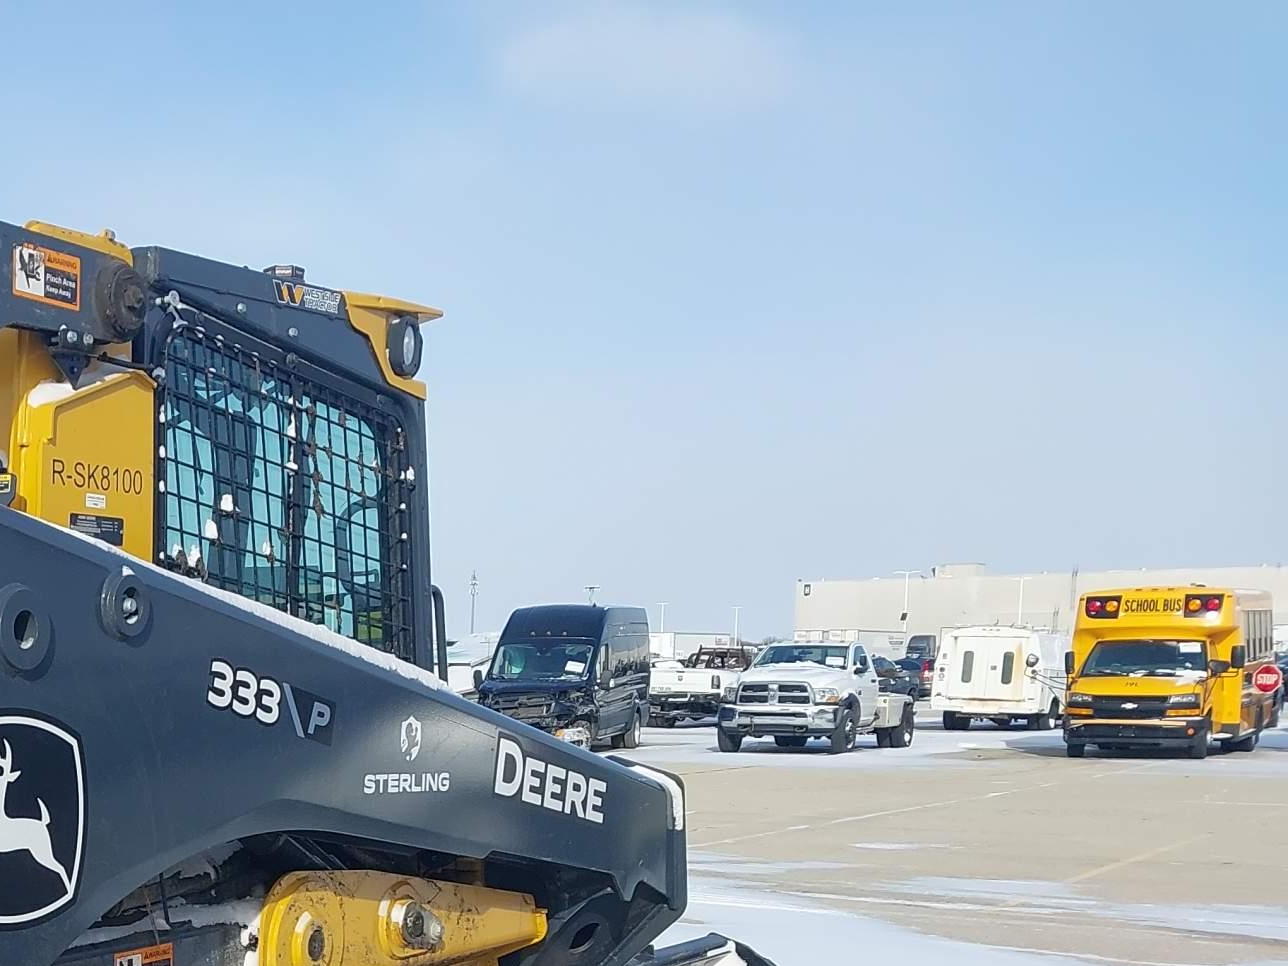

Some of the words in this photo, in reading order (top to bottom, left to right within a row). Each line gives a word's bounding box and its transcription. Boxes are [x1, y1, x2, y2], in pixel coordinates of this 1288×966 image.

[46, 273, 62, 284] Pinch
[63, 277, 76, 288] Area
[52, 458, 143, 495] R-SK8100
[1124, 599, 1161, 613] SCHOOL
[1162, 598, 1183, 612] BUS
[1256, 673, 1279, 685] STOP
[363, 772, 450, 794] STERLING
[494, 737, 608, 824] DEERE
